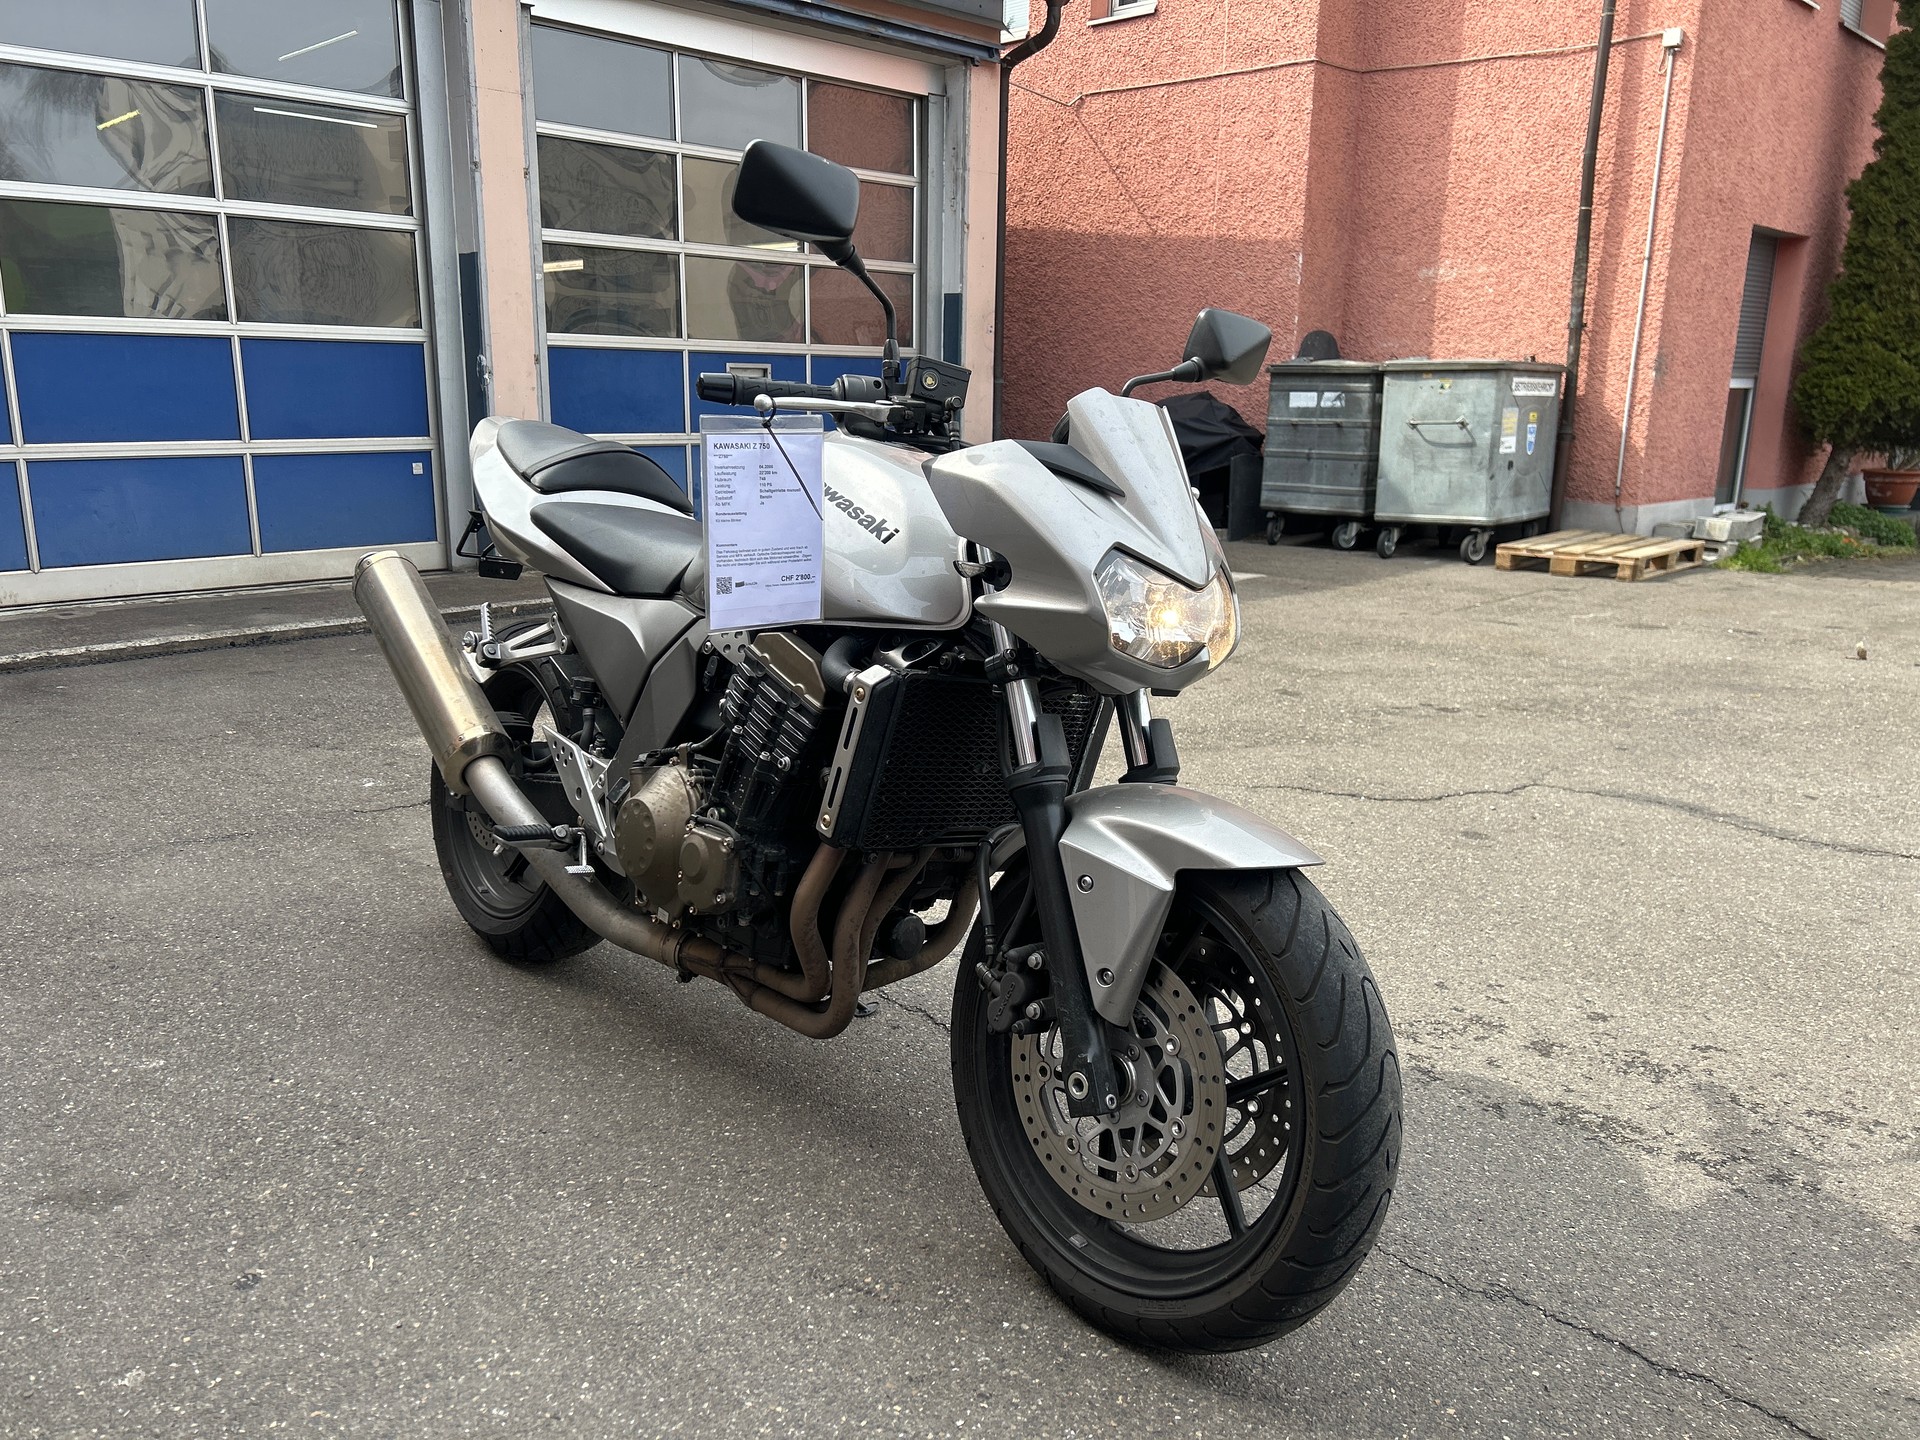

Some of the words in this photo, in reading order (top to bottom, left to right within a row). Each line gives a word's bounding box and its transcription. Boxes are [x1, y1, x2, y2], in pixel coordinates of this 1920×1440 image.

[713, 442, 751, 450] KAWASAKI
[752, 442, 758, 450] Z
[759, 442, 771, 450] 750
[824, 482, 900, 545] wasaki
[780, 574, 795, 582] CHF
